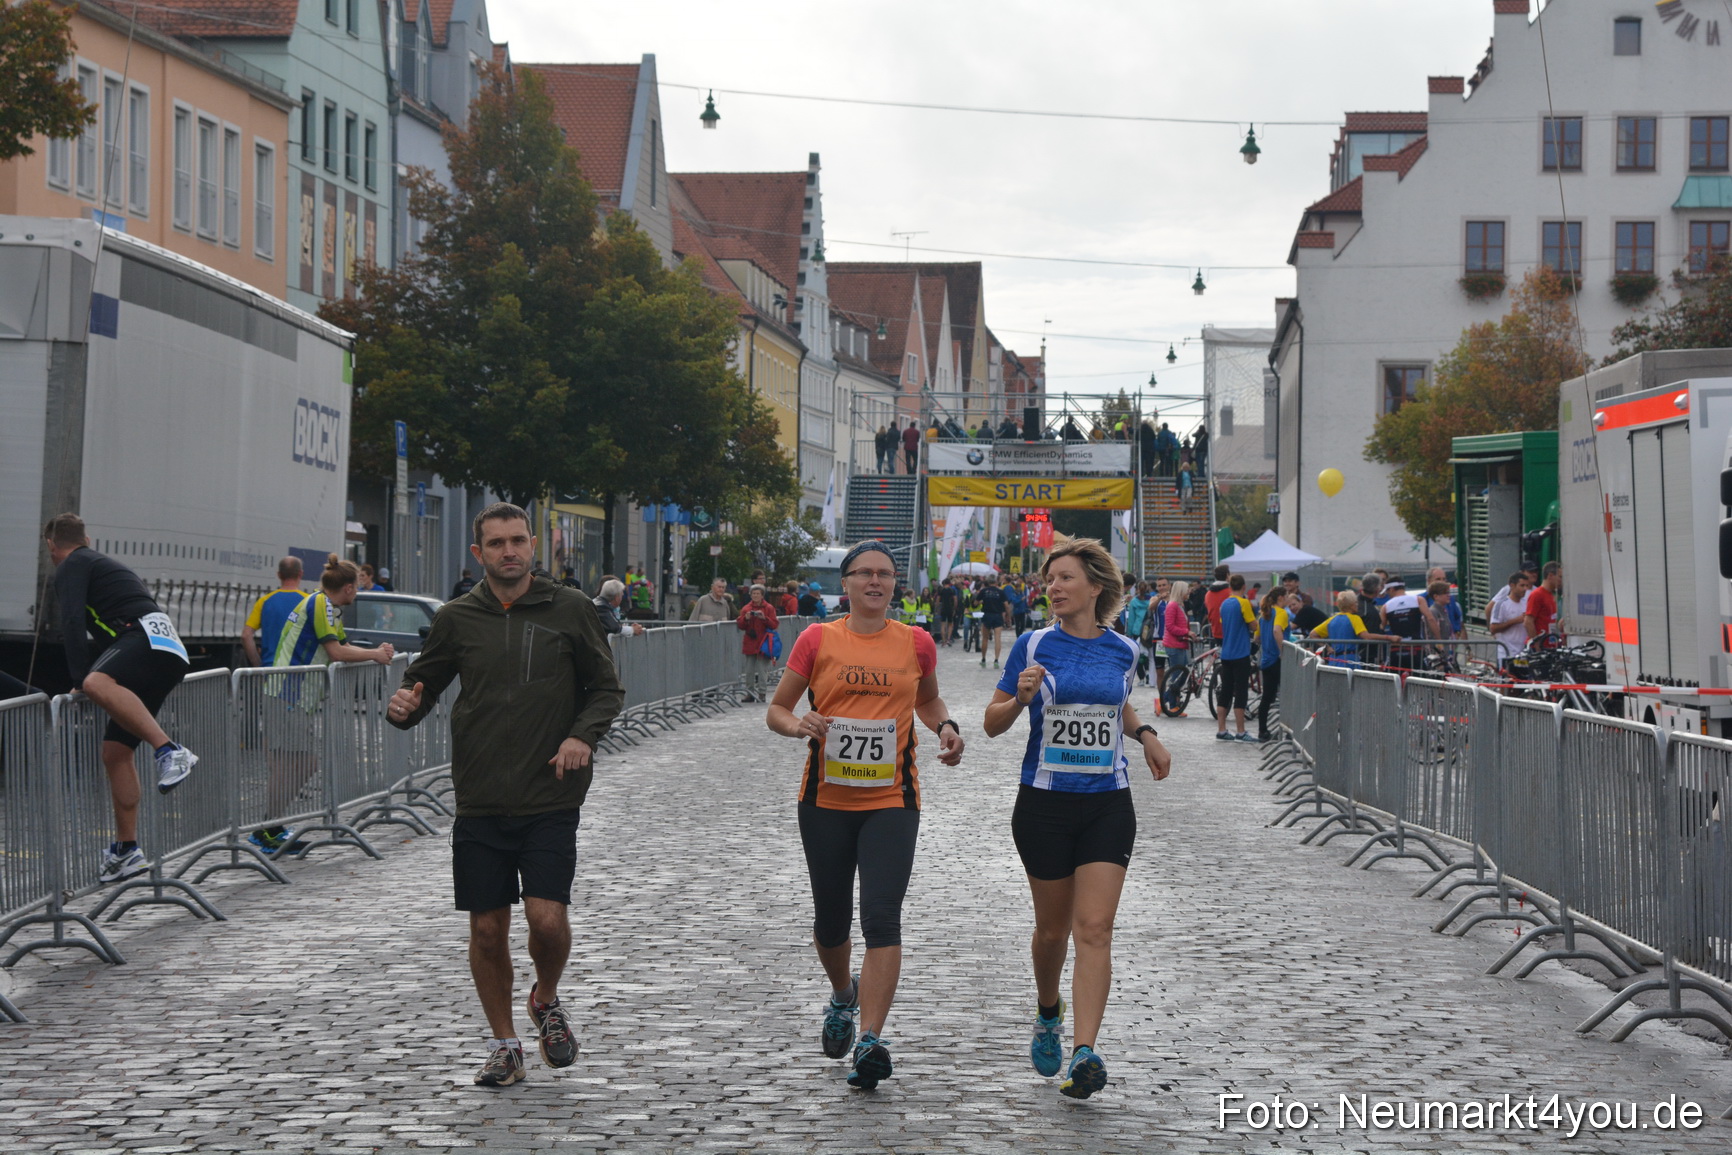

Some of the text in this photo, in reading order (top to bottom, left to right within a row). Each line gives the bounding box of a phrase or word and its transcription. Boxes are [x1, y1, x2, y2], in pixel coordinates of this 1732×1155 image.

[292, 397, 341, 472] BOCK
[995, 484, 1066, 501] START
[1012, 561, 1019, 569] A
[846, 672, 893, 687] OEXL
[1046, 708, 1106, 718] PARTL Neumarkt
[851, 725, 886, 733] Neumarkt
[1052, 719, 1111, 747] 2936
[838, 735, 884, 761] 275
[1061, 752, 1101, 764] Melanie
[842, 766, 877, 778] Monika
